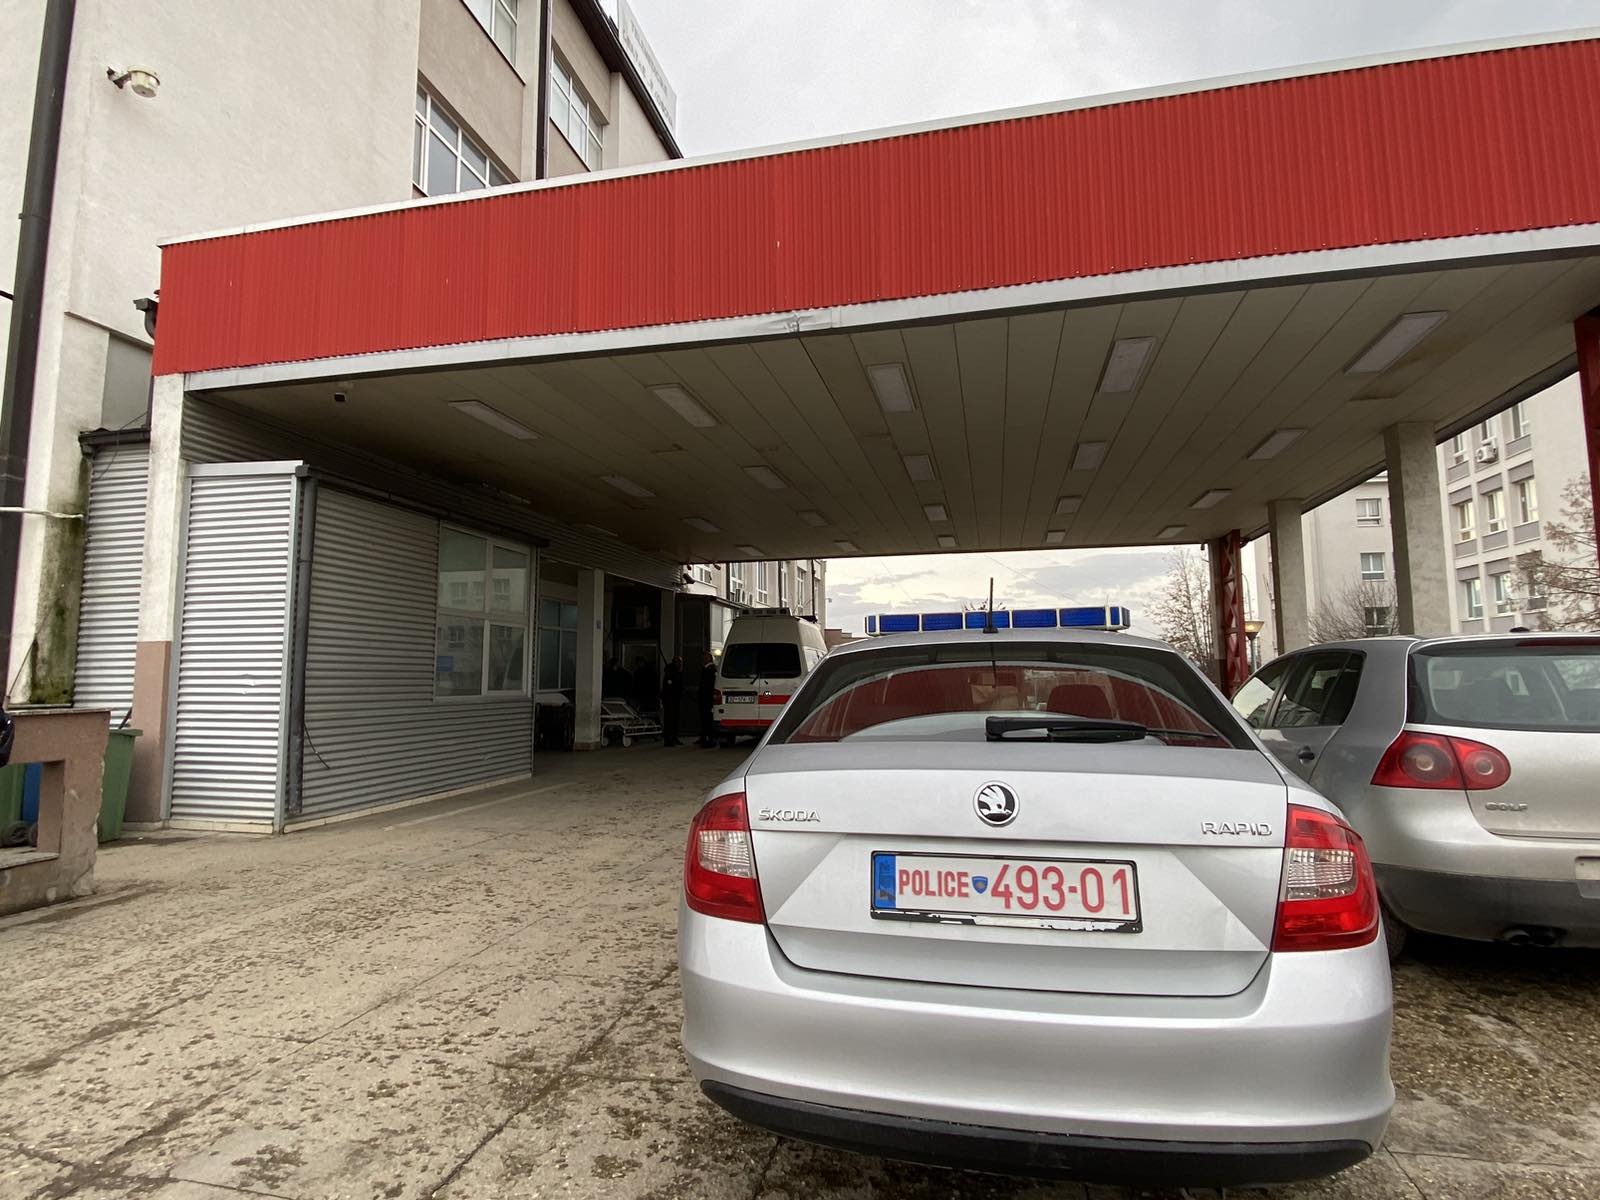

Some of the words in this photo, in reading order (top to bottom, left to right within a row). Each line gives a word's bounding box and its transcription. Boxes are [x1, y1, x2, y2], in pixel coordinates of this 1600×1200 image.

[1485, 801, 1529, 812] GOLF
[1200, 821, 1273, 836] RAPID
[899, 869, 969, 898] POLICE
[990, 863, 1131, 915] 493-01
